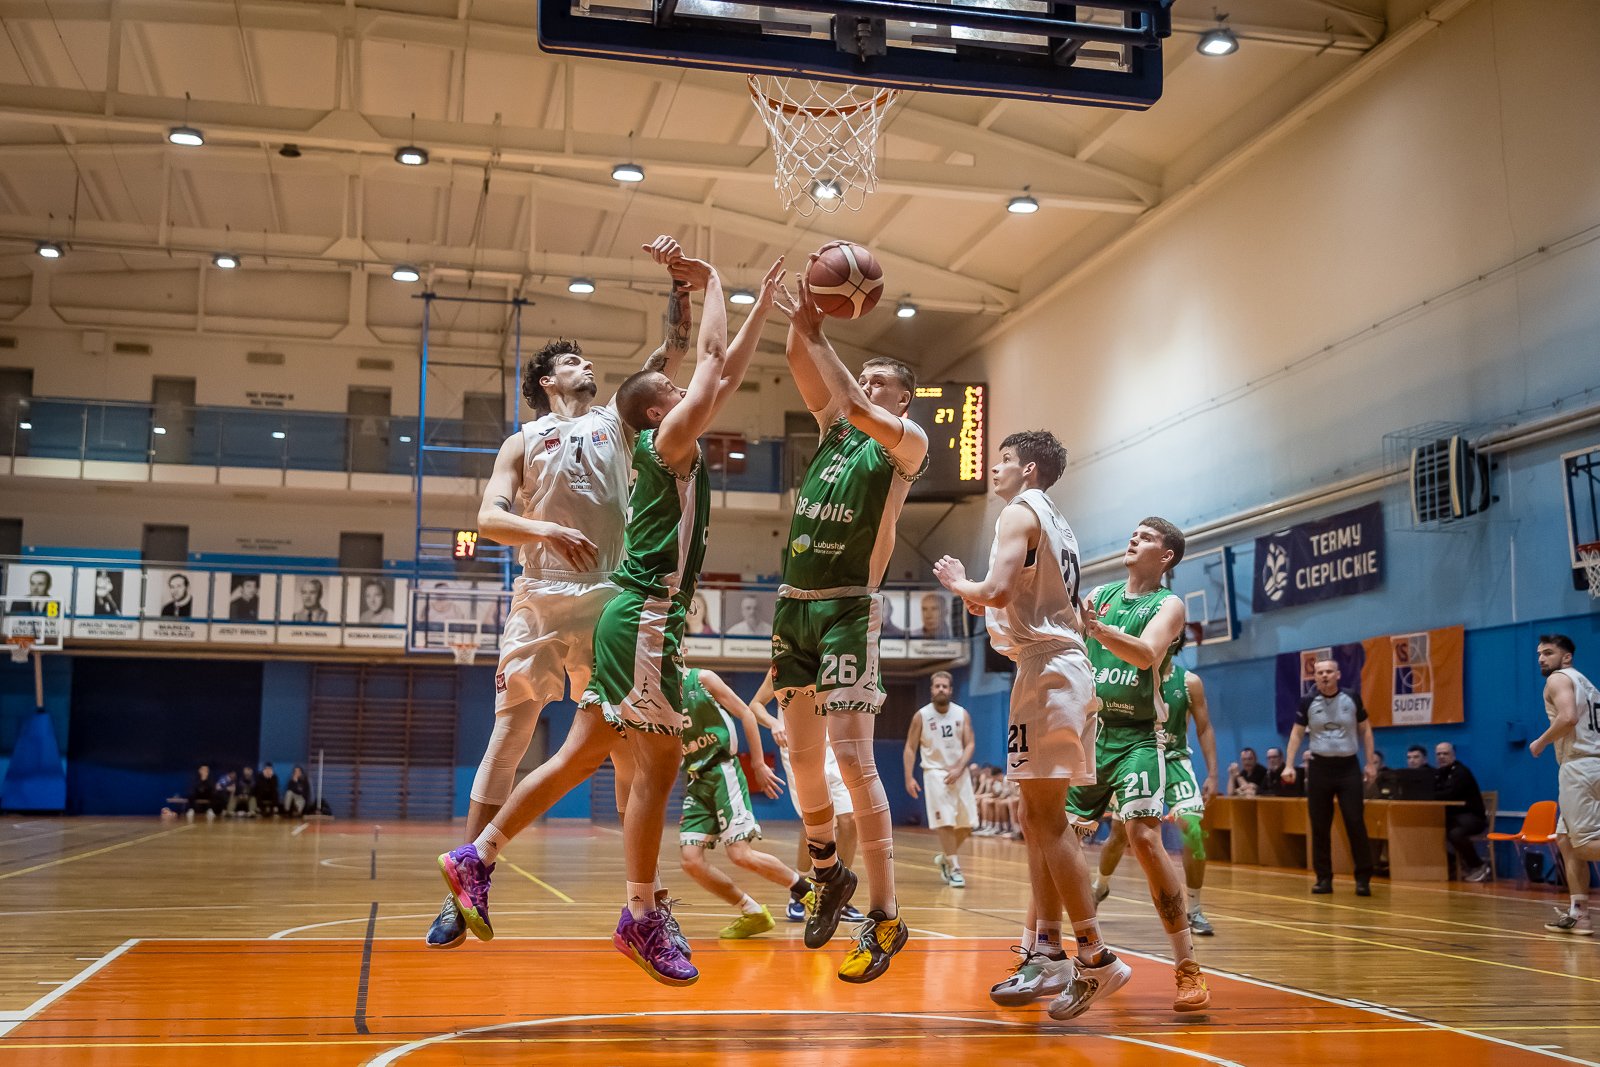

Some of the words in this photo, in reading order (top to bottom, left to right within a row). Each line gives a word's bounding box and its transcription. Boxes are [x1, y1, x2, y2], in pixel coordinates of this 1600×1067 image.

[935, 408, 955, 423] 27
[570, 436, 584, 463] 7
[949, 437, 956, 449] 1
[820, 503, 854, 523] Oils
[455, 542, 475, 557] 37
[1309, 523, 1362, 557] TERMY
[1295, 550, 1378, 590] CIEPLICKIE
[821, 654, 857, 685] 26
[1108, 667, 1139, 687] Oils
[1394, 697, 1432, 712] SUDETY
[941, 724, 953, 737] 12
[1008, 724, 1029, 753] 21
[1123, 771, 1152, 798] 21
[1172, 780, 1194, 801] 10
[716, 808, 728, 830] 5
